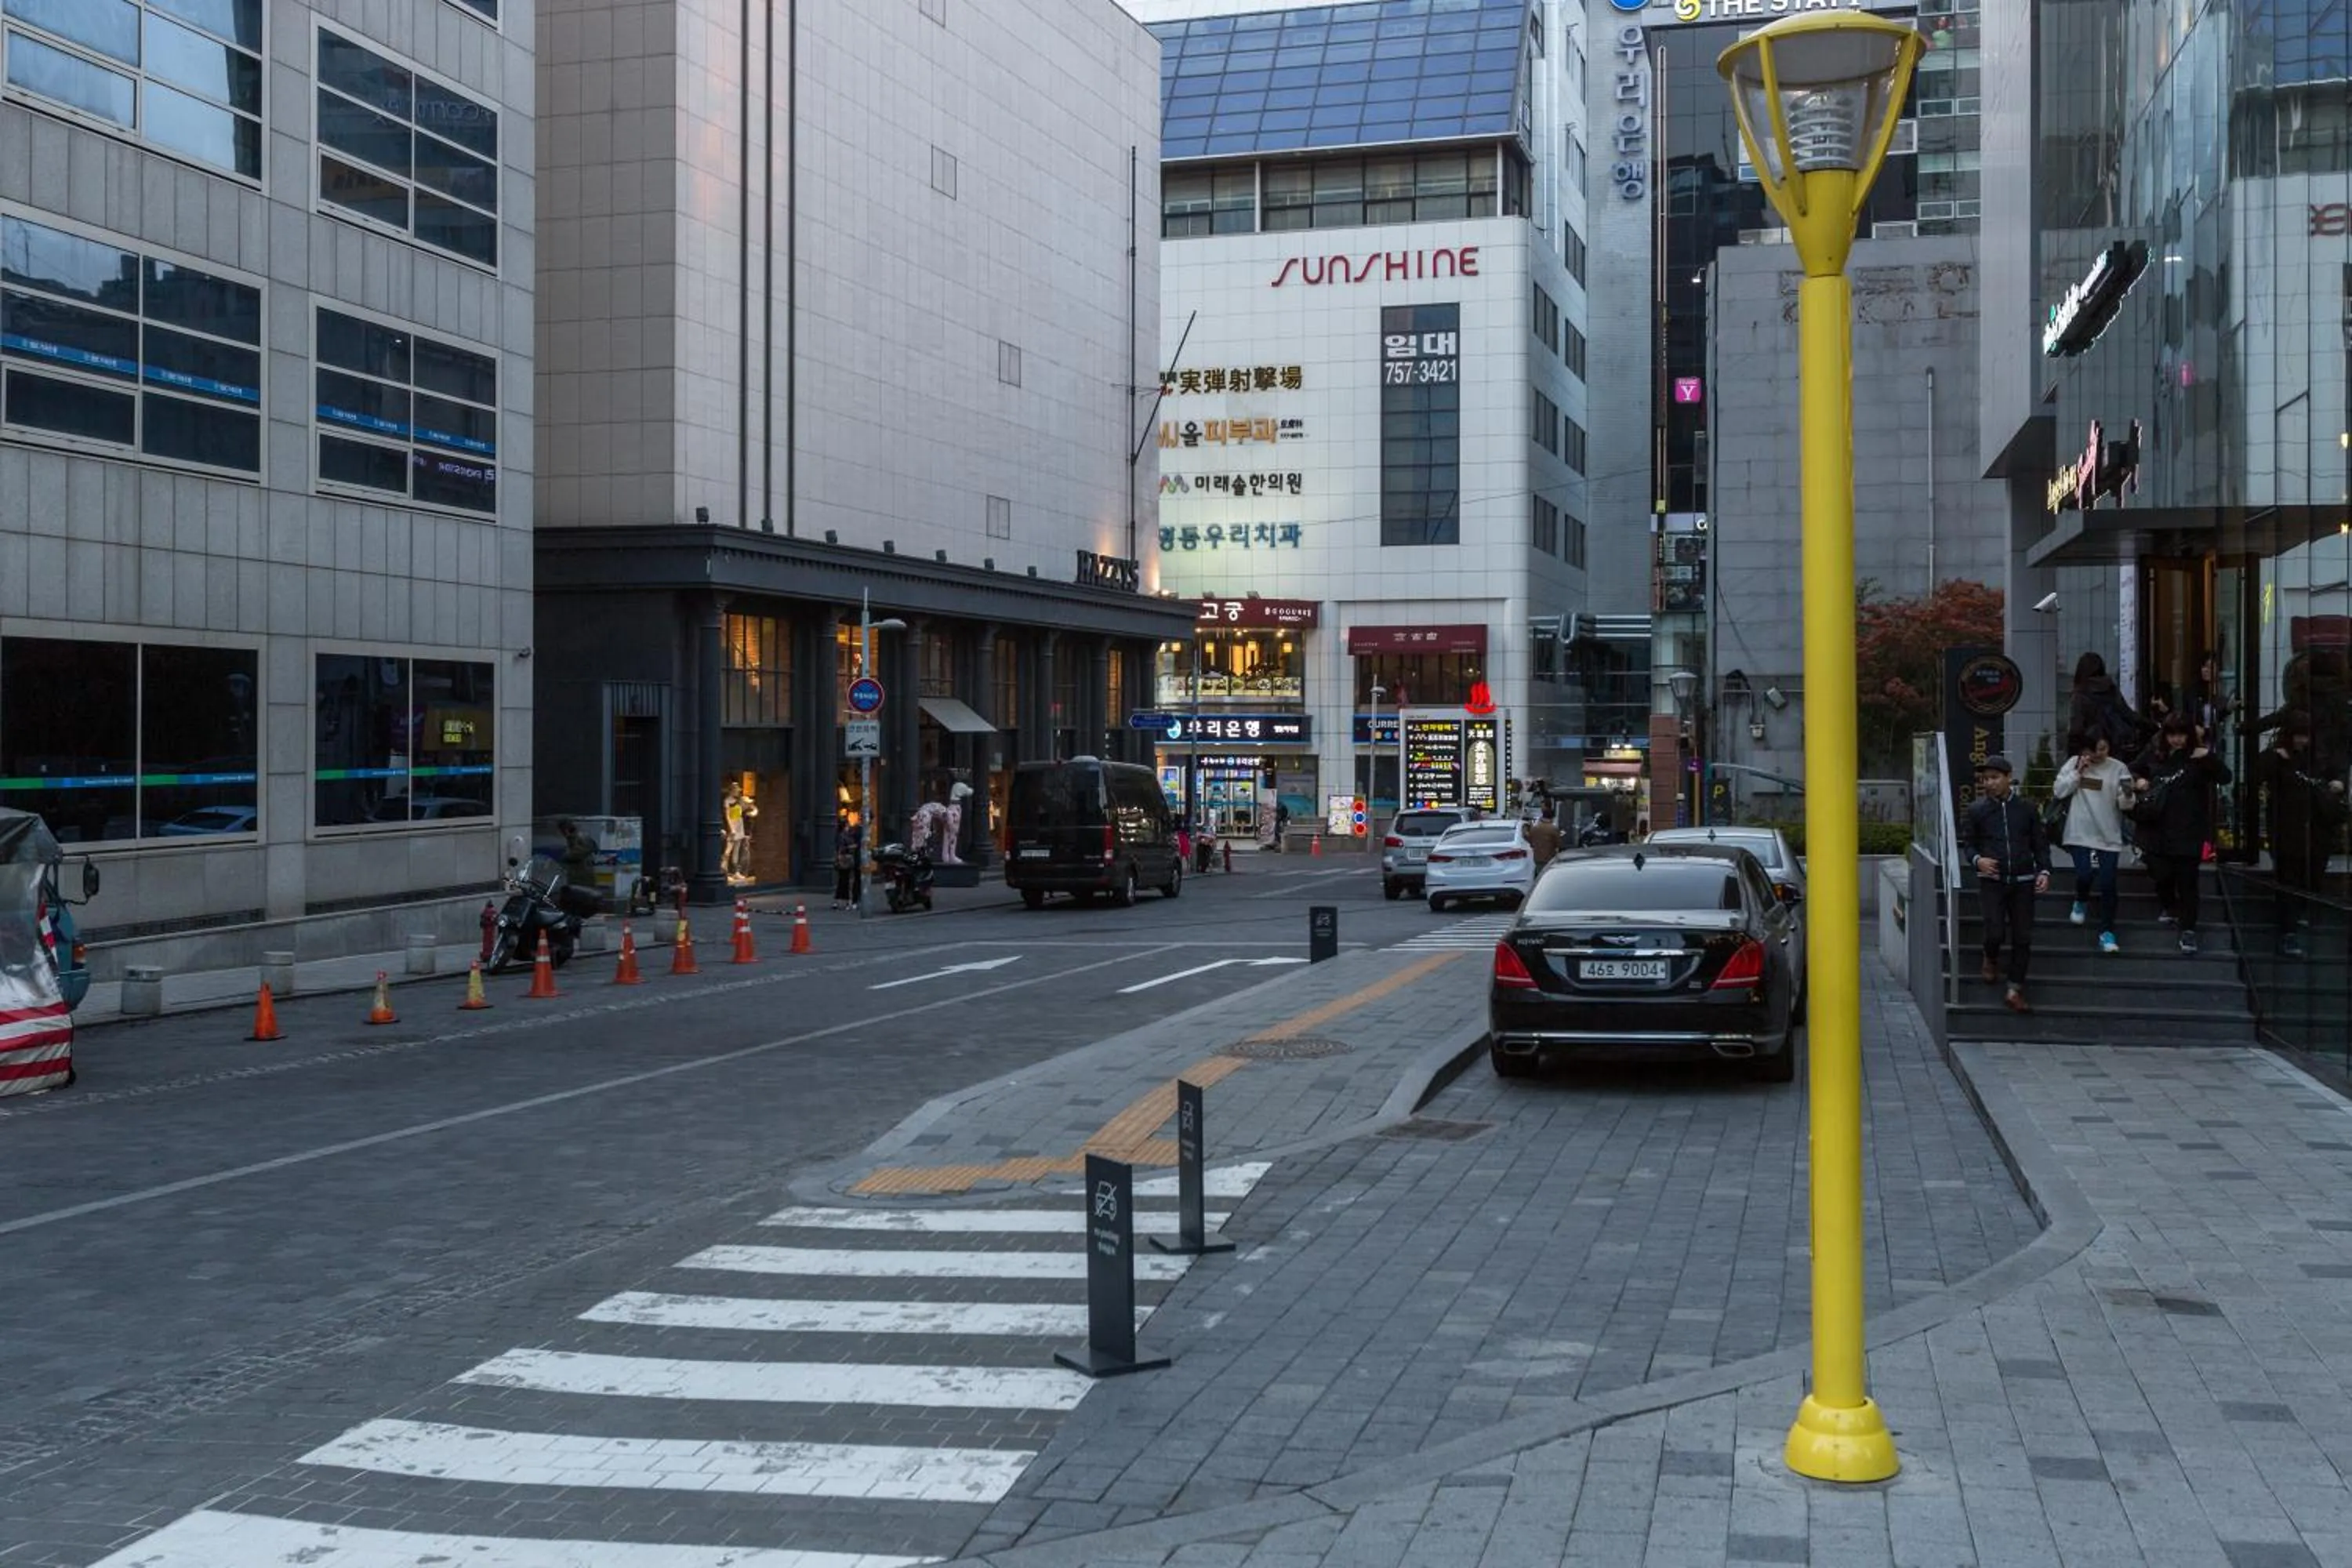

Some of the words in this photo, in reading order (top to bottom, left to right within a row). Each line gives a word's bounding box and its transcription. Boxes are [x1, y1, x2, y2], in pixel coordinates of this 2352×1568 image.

[1617, 26, 1646, 201] 우리은행
[1271, 246, 1480, 288] SUNSHINE
[1385, 332, 1456, 358] 임대
[1385, 360, 1457, 384] 757-3421
